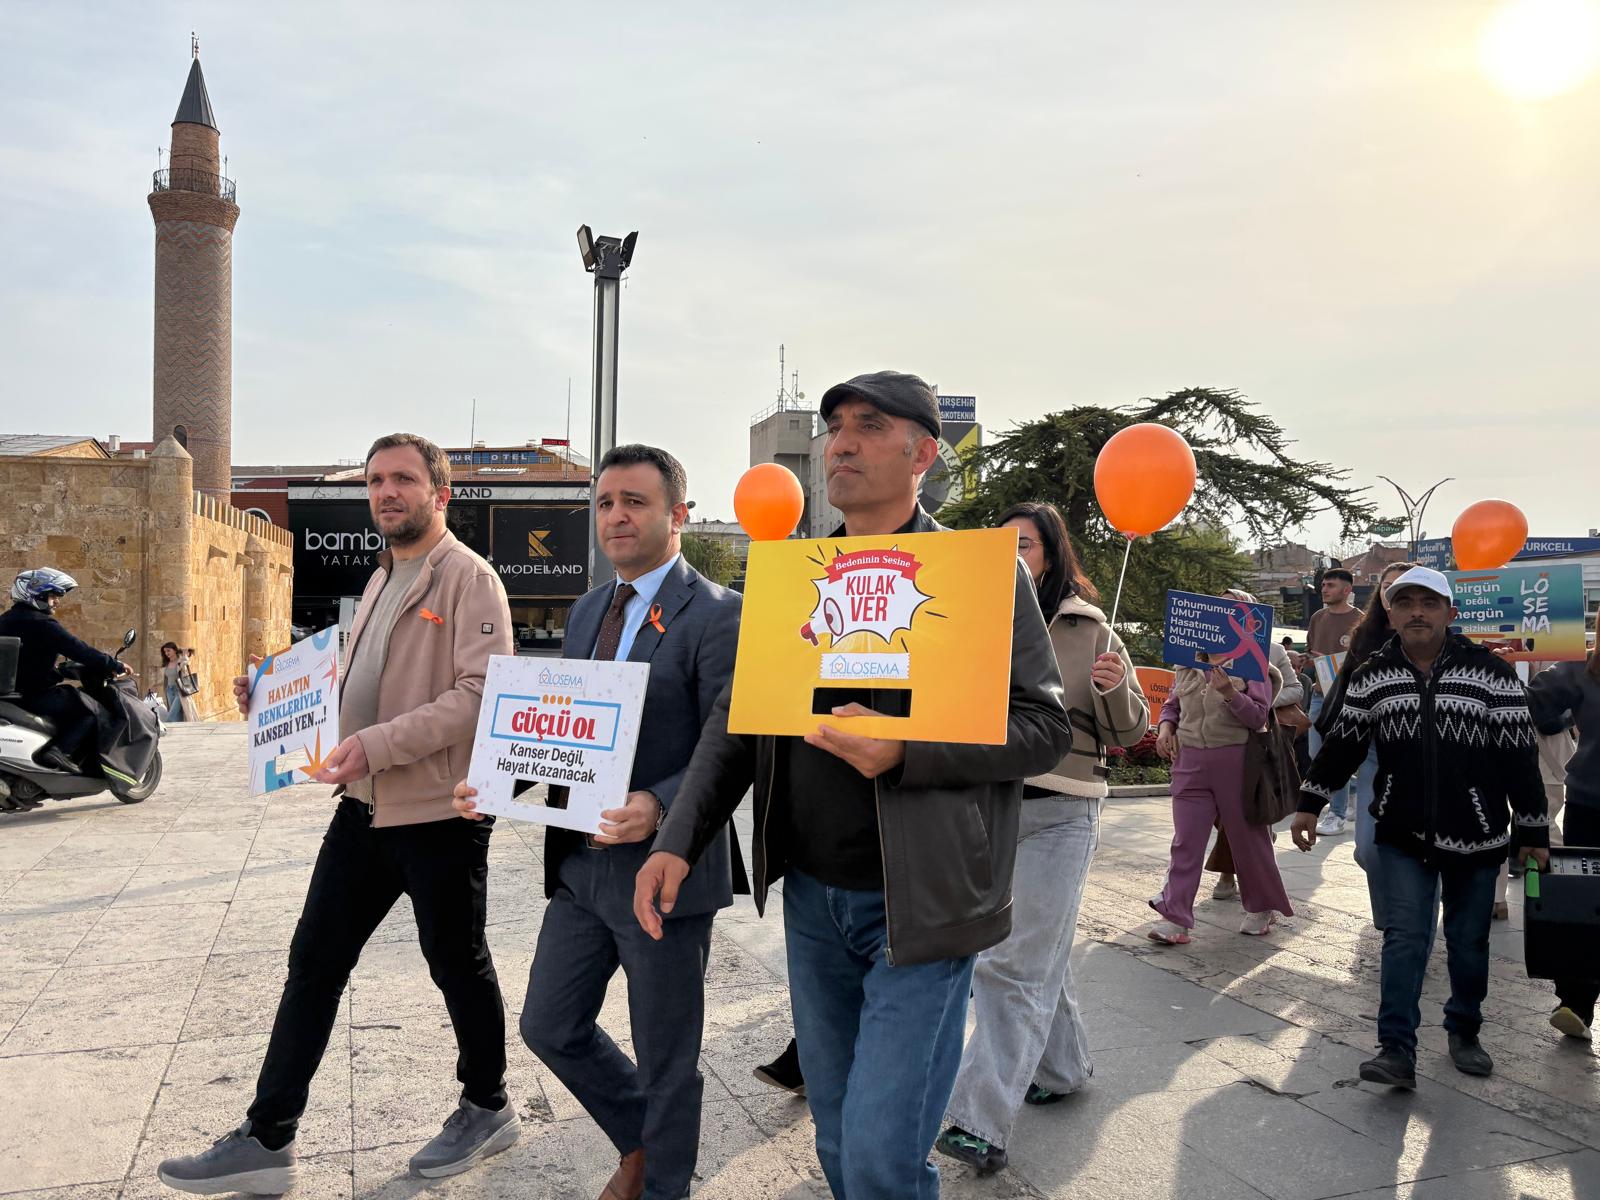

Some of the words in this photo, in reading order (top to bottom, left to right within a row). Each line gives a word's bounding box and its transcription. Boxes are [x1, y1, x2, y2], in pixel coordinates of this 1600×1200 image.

[321, 555, 370, 565] YATAK
[835, 555, 880, 570] Bedeninin
[882, 554, 911, 568] Sesine
[846, 574, 896, 596] KULAK
[1455, 582, 1500, 596] birgün
[1520, 572, 1549, 596] LÖ
[850, 596, 888, 622] VER
[1172, 597, 1236, 616] Tohumumuz
[1466, 597, 1490, 605] DEĞİL
[1523, 596, 1548, 614] SE
[1171, 607, 1202, 619] UMUT
[1170, 617, 1220, 633] Hasatımız
[1521, 615, 1552, 634] MA
[1168, 636, 1206, 650] Olsun...
[1169, 626, 1226, 644] MUTLULUK
[268, 674, 310, 705] HAYATIN
[258, 689, 322, 728] RENKLERİYLE
[254, 715, 292, 748] KANSERİ
[294, 705, 327, 732] YEN...!
[512, 706, 571, 741] GÜÇLÜ
[572, 716, 596, 740] OL
[510, 743, 550, 760] Kanser
[551, 748, 585, 767] Değil,
[496, 758, 529, 776] Hayat
[531, 762, 596, 784] Kazanacak
